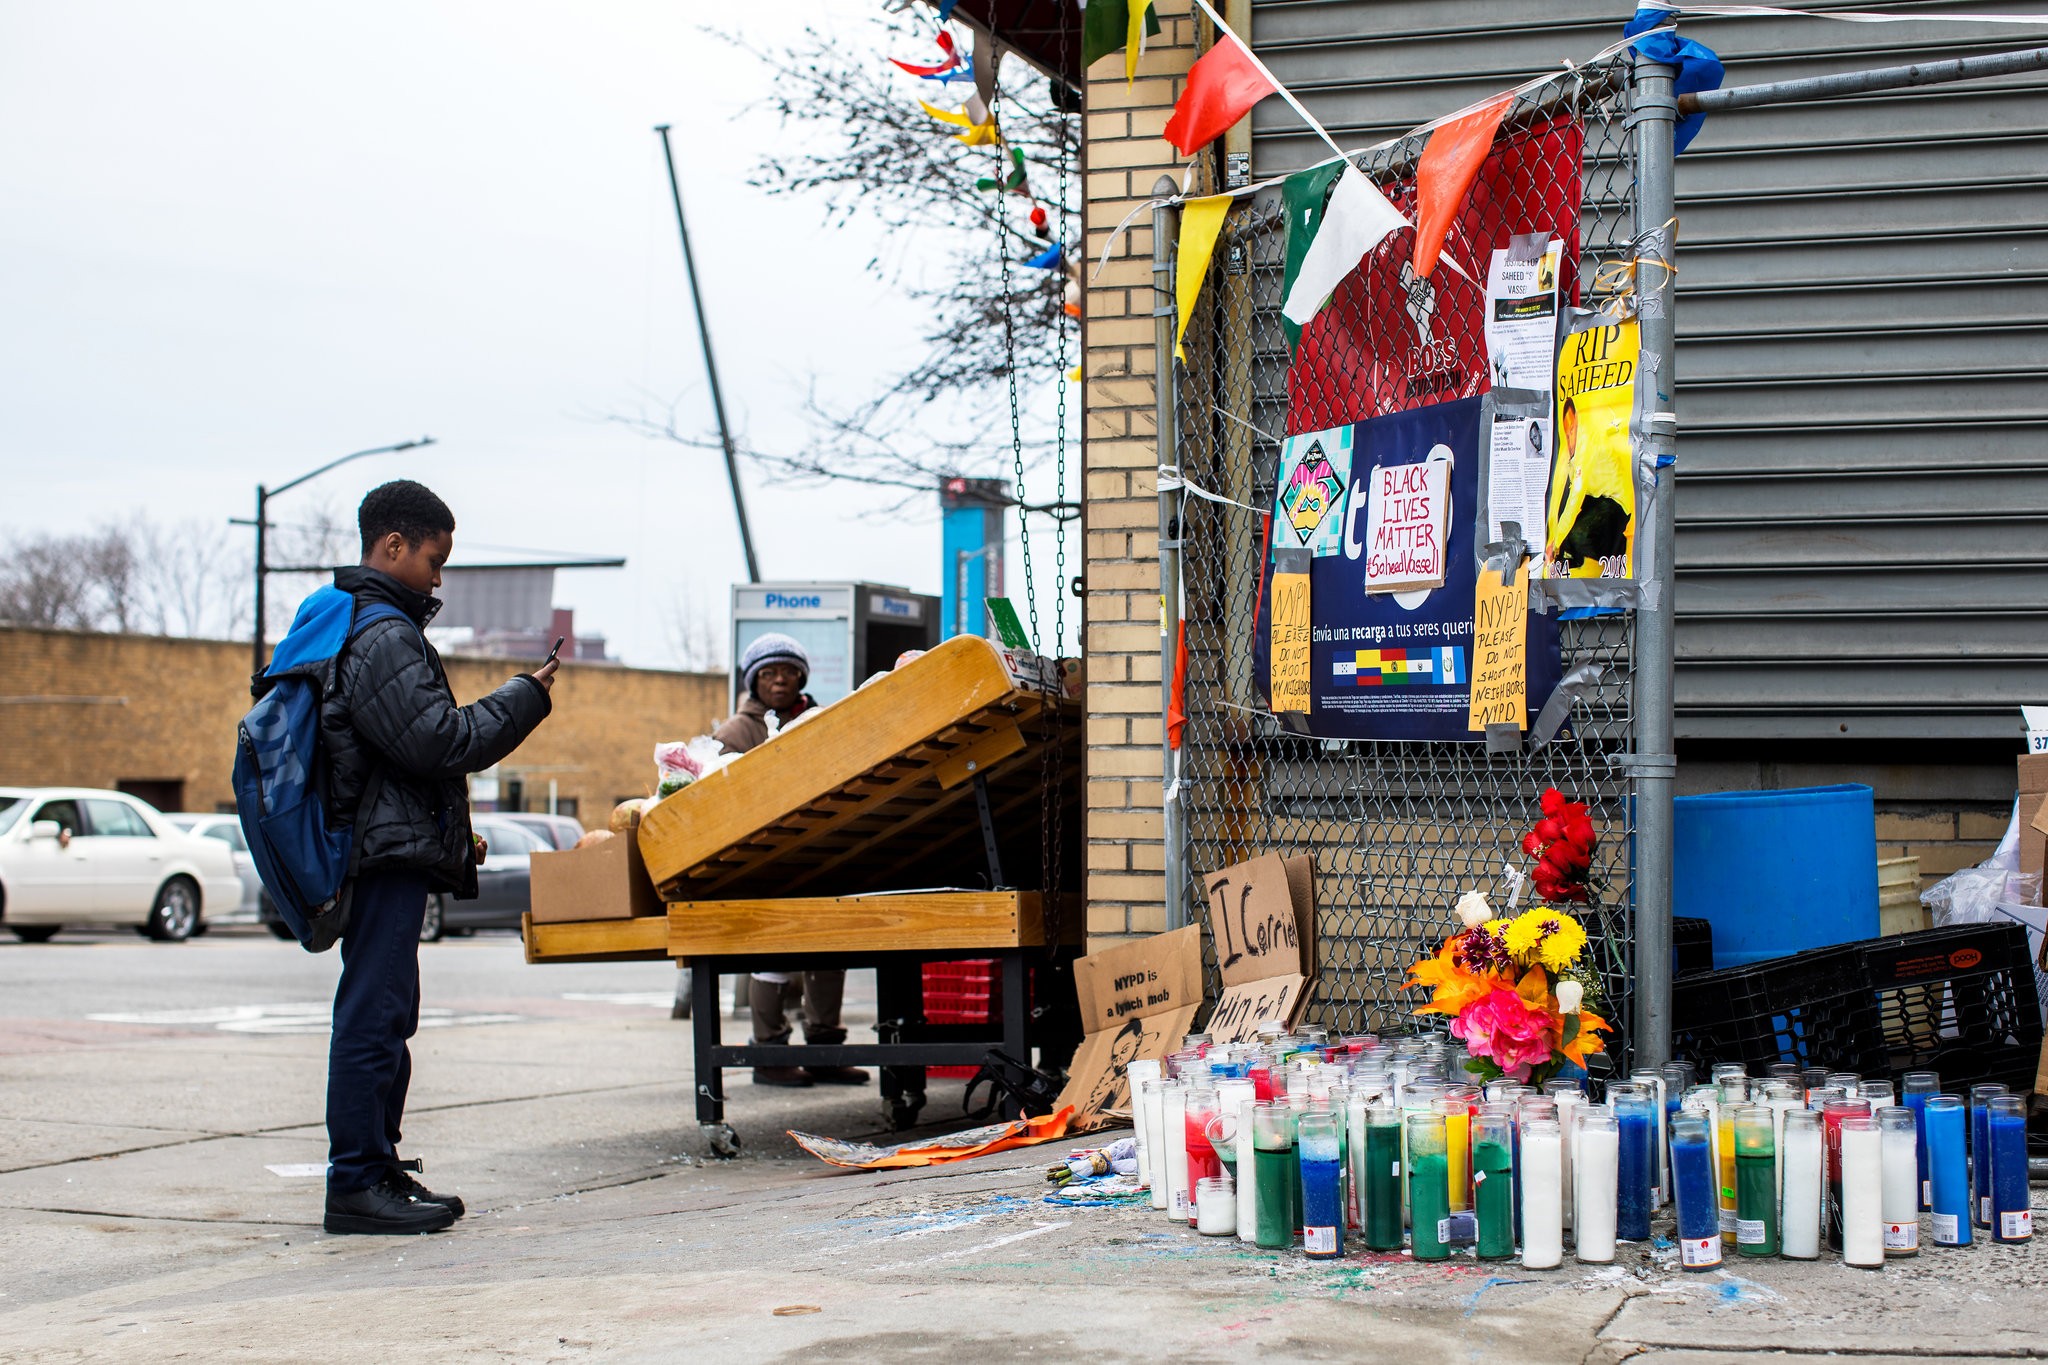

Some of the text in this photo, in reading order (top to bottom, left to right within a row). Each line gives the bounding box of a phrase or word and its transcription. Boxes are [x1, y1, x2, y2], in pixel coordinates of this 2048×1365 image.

[1501, 271, 1525, 281] SAHEED
[1407, 336, 1458, 378] BOSS
[1574, 323, 1621, 367] RIP
[1560, 360, 1633, 402] SAHEED
[1383, 466, 1429, 497] BLACK
[1383, 497, 1430, 524] LIVES
[1374, 523, 1436, 550] MATTER
[1598, 554, 1627, 579] 2018
[765, 593, 821, 608] Phone
[882, 597, 909, 616] Phone
[1312, 616, 1475, 643] Envía una recarga a tus seres queri
[1477, 627, 1516, 649] PLEASE
[1279, 647, 1308, 661] DO NOT
[1486, 643, 1522, 665] DO NOT
[1477, 663, 1522, 682] SHOOT MY
[1475, 680, 1525, 704] NEIGHBORS
[1210, 878, 1243, 968] I
[1953, 953, 1978, 966] Hood
[1114, 969, 1158, 992] NYPD is
[1107, 990, 1170, 1018] a lynch mob
